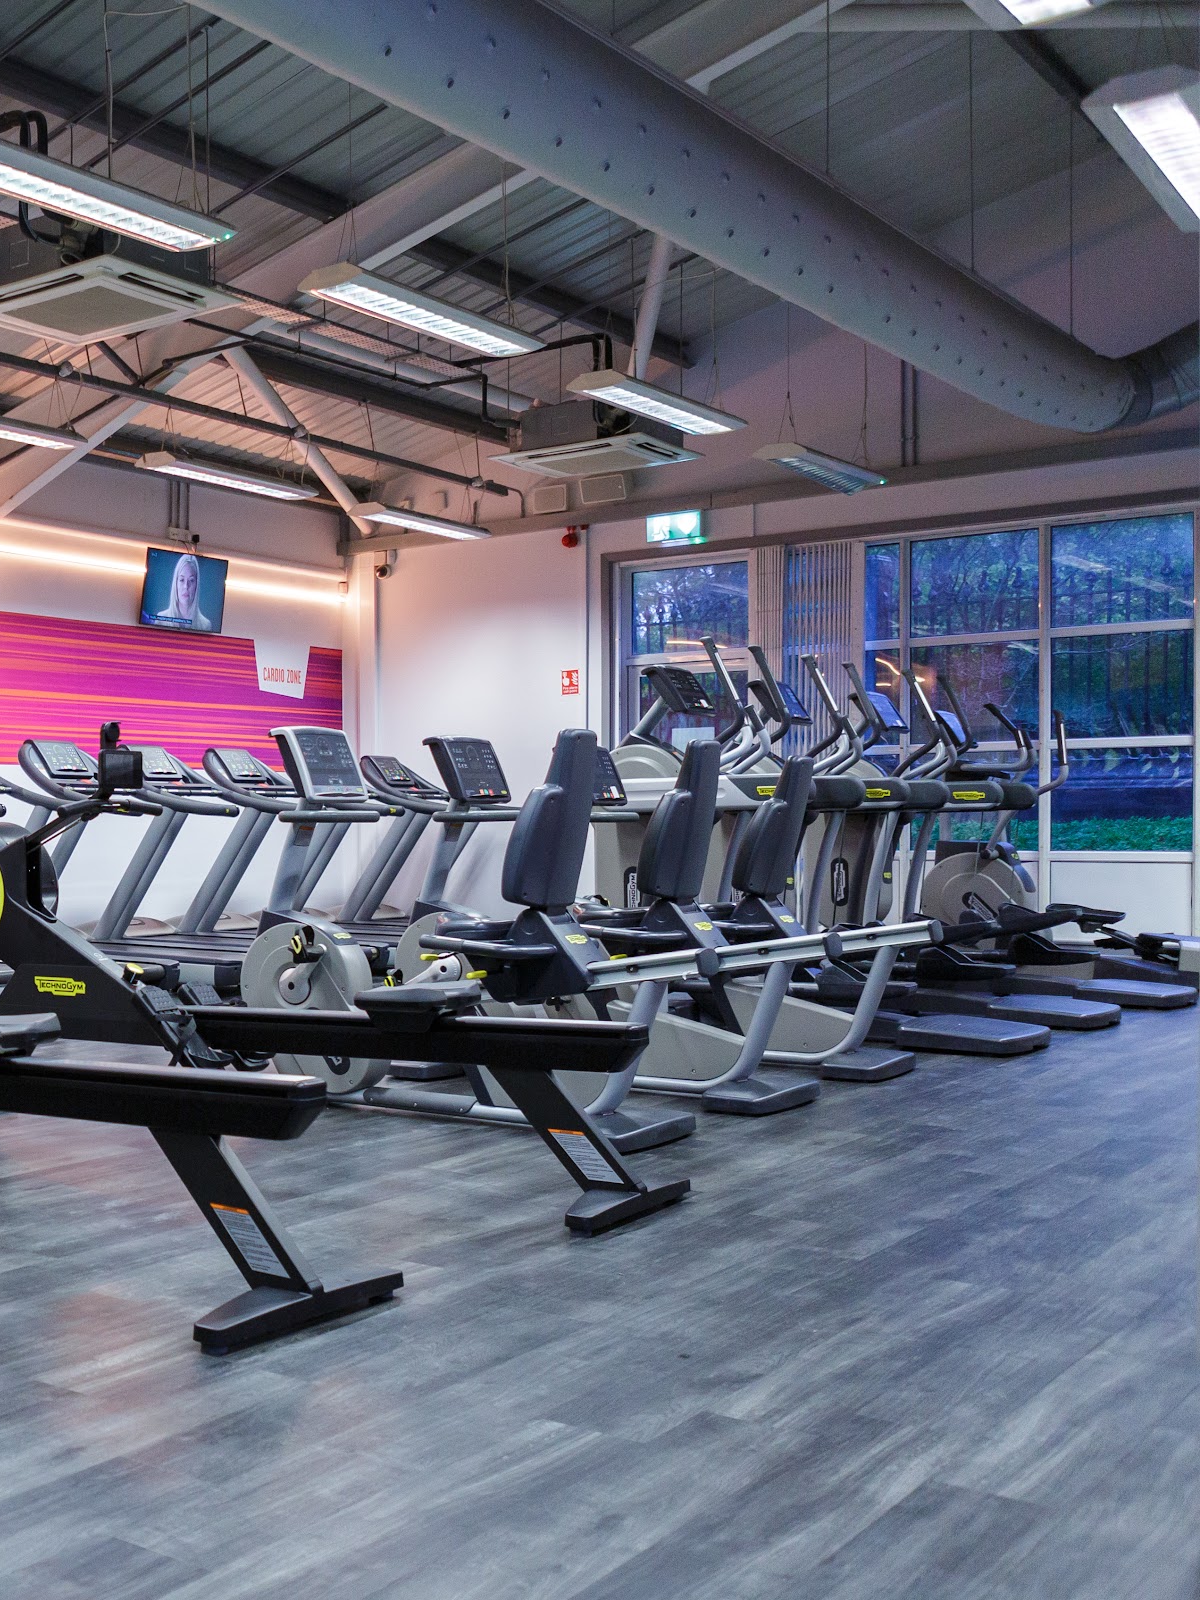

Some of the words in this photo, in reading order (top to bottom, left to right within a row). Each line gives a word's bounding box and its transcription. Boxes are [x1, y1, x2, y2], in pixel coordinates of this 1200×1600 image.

[263, 667, 284, 682] CARDIO
[287, 670, 301, 684] ZONE
[36, 978, 84, 992] TECHNOGYM
